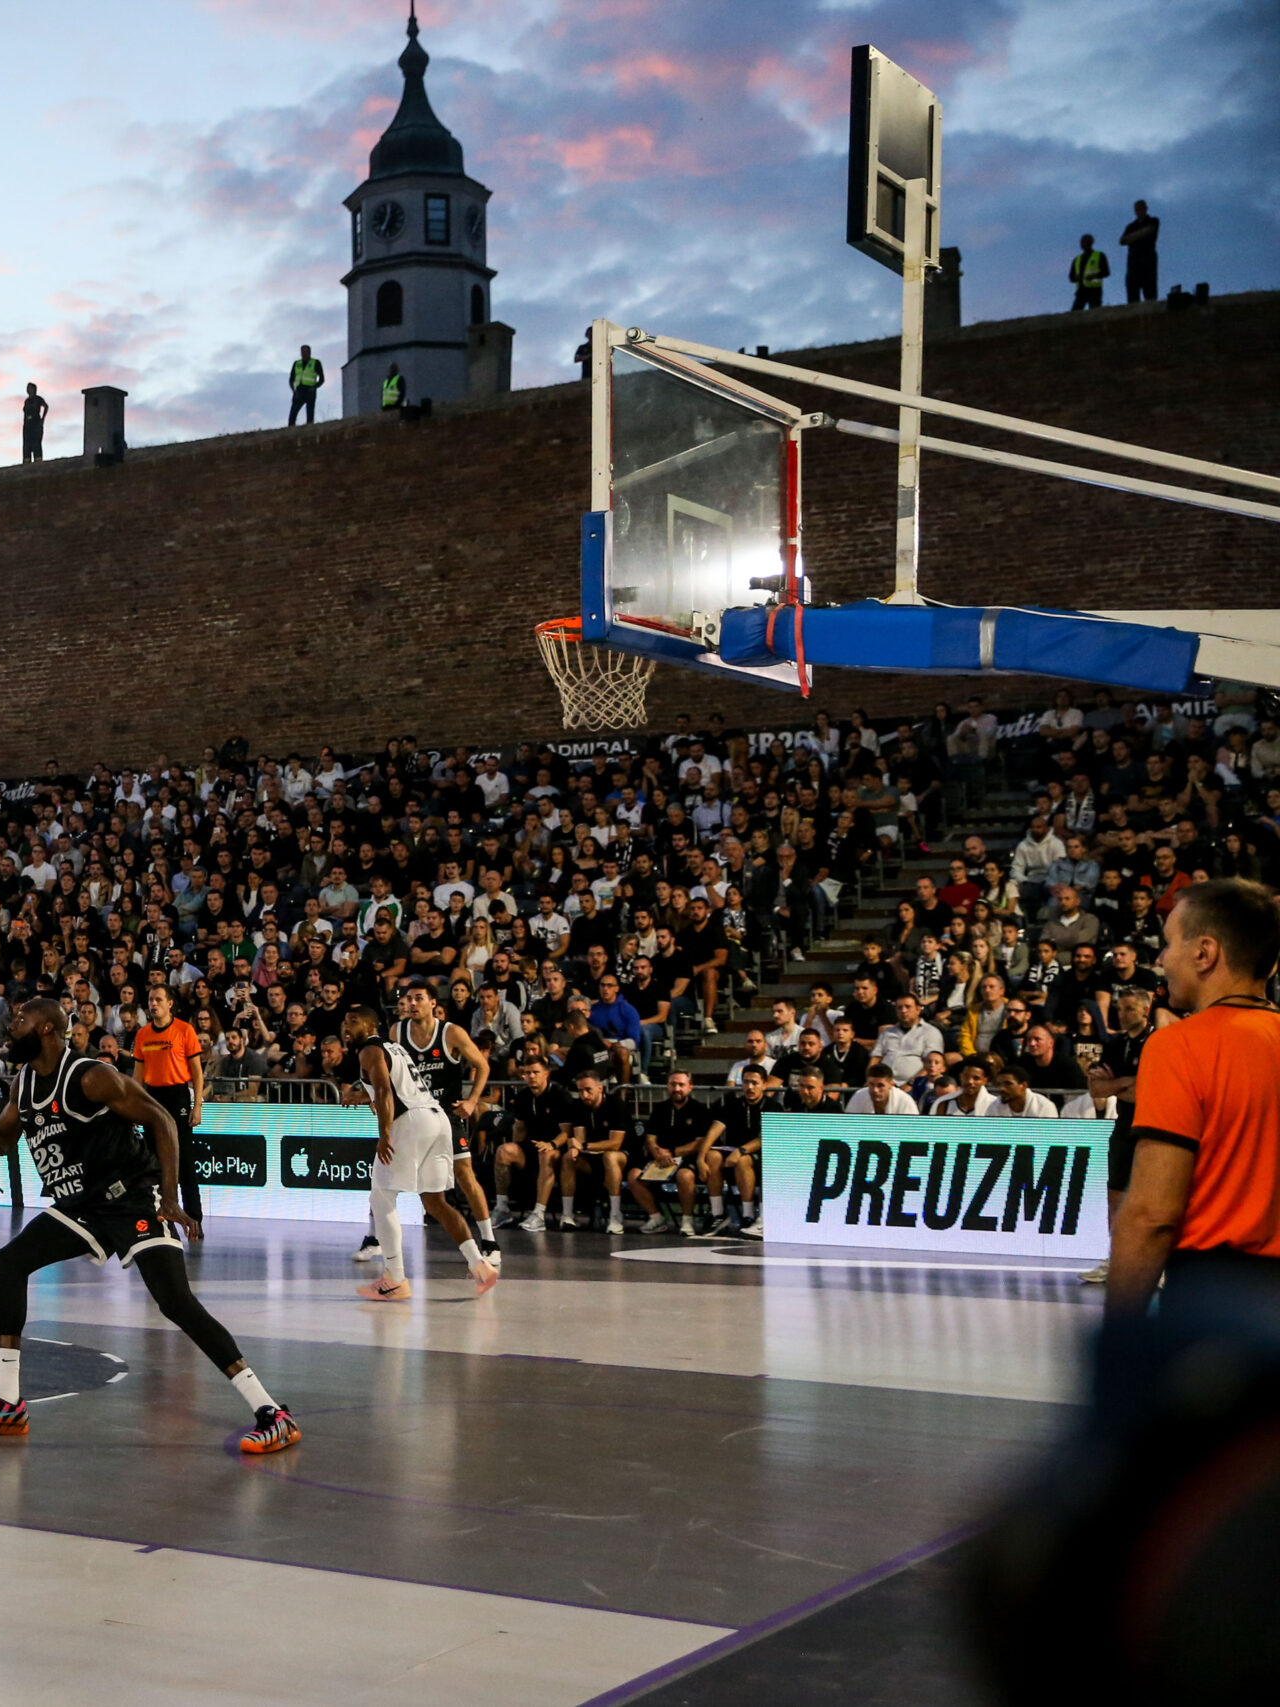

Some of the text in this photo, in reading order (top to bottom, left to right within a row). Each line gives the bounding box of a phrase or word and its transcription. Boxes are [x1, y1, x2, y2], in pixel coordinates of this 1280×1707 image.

[33, 1143, 64, 1174] 23
[226, 1157, 257, 1178] Play
[43, 1162, 84, 1187] ZZART
[317, 1160, 352, 1182] App
[54, 1179, 84, 1198] NIS
[805, 1138, 1092, 1235] PREUZMI
